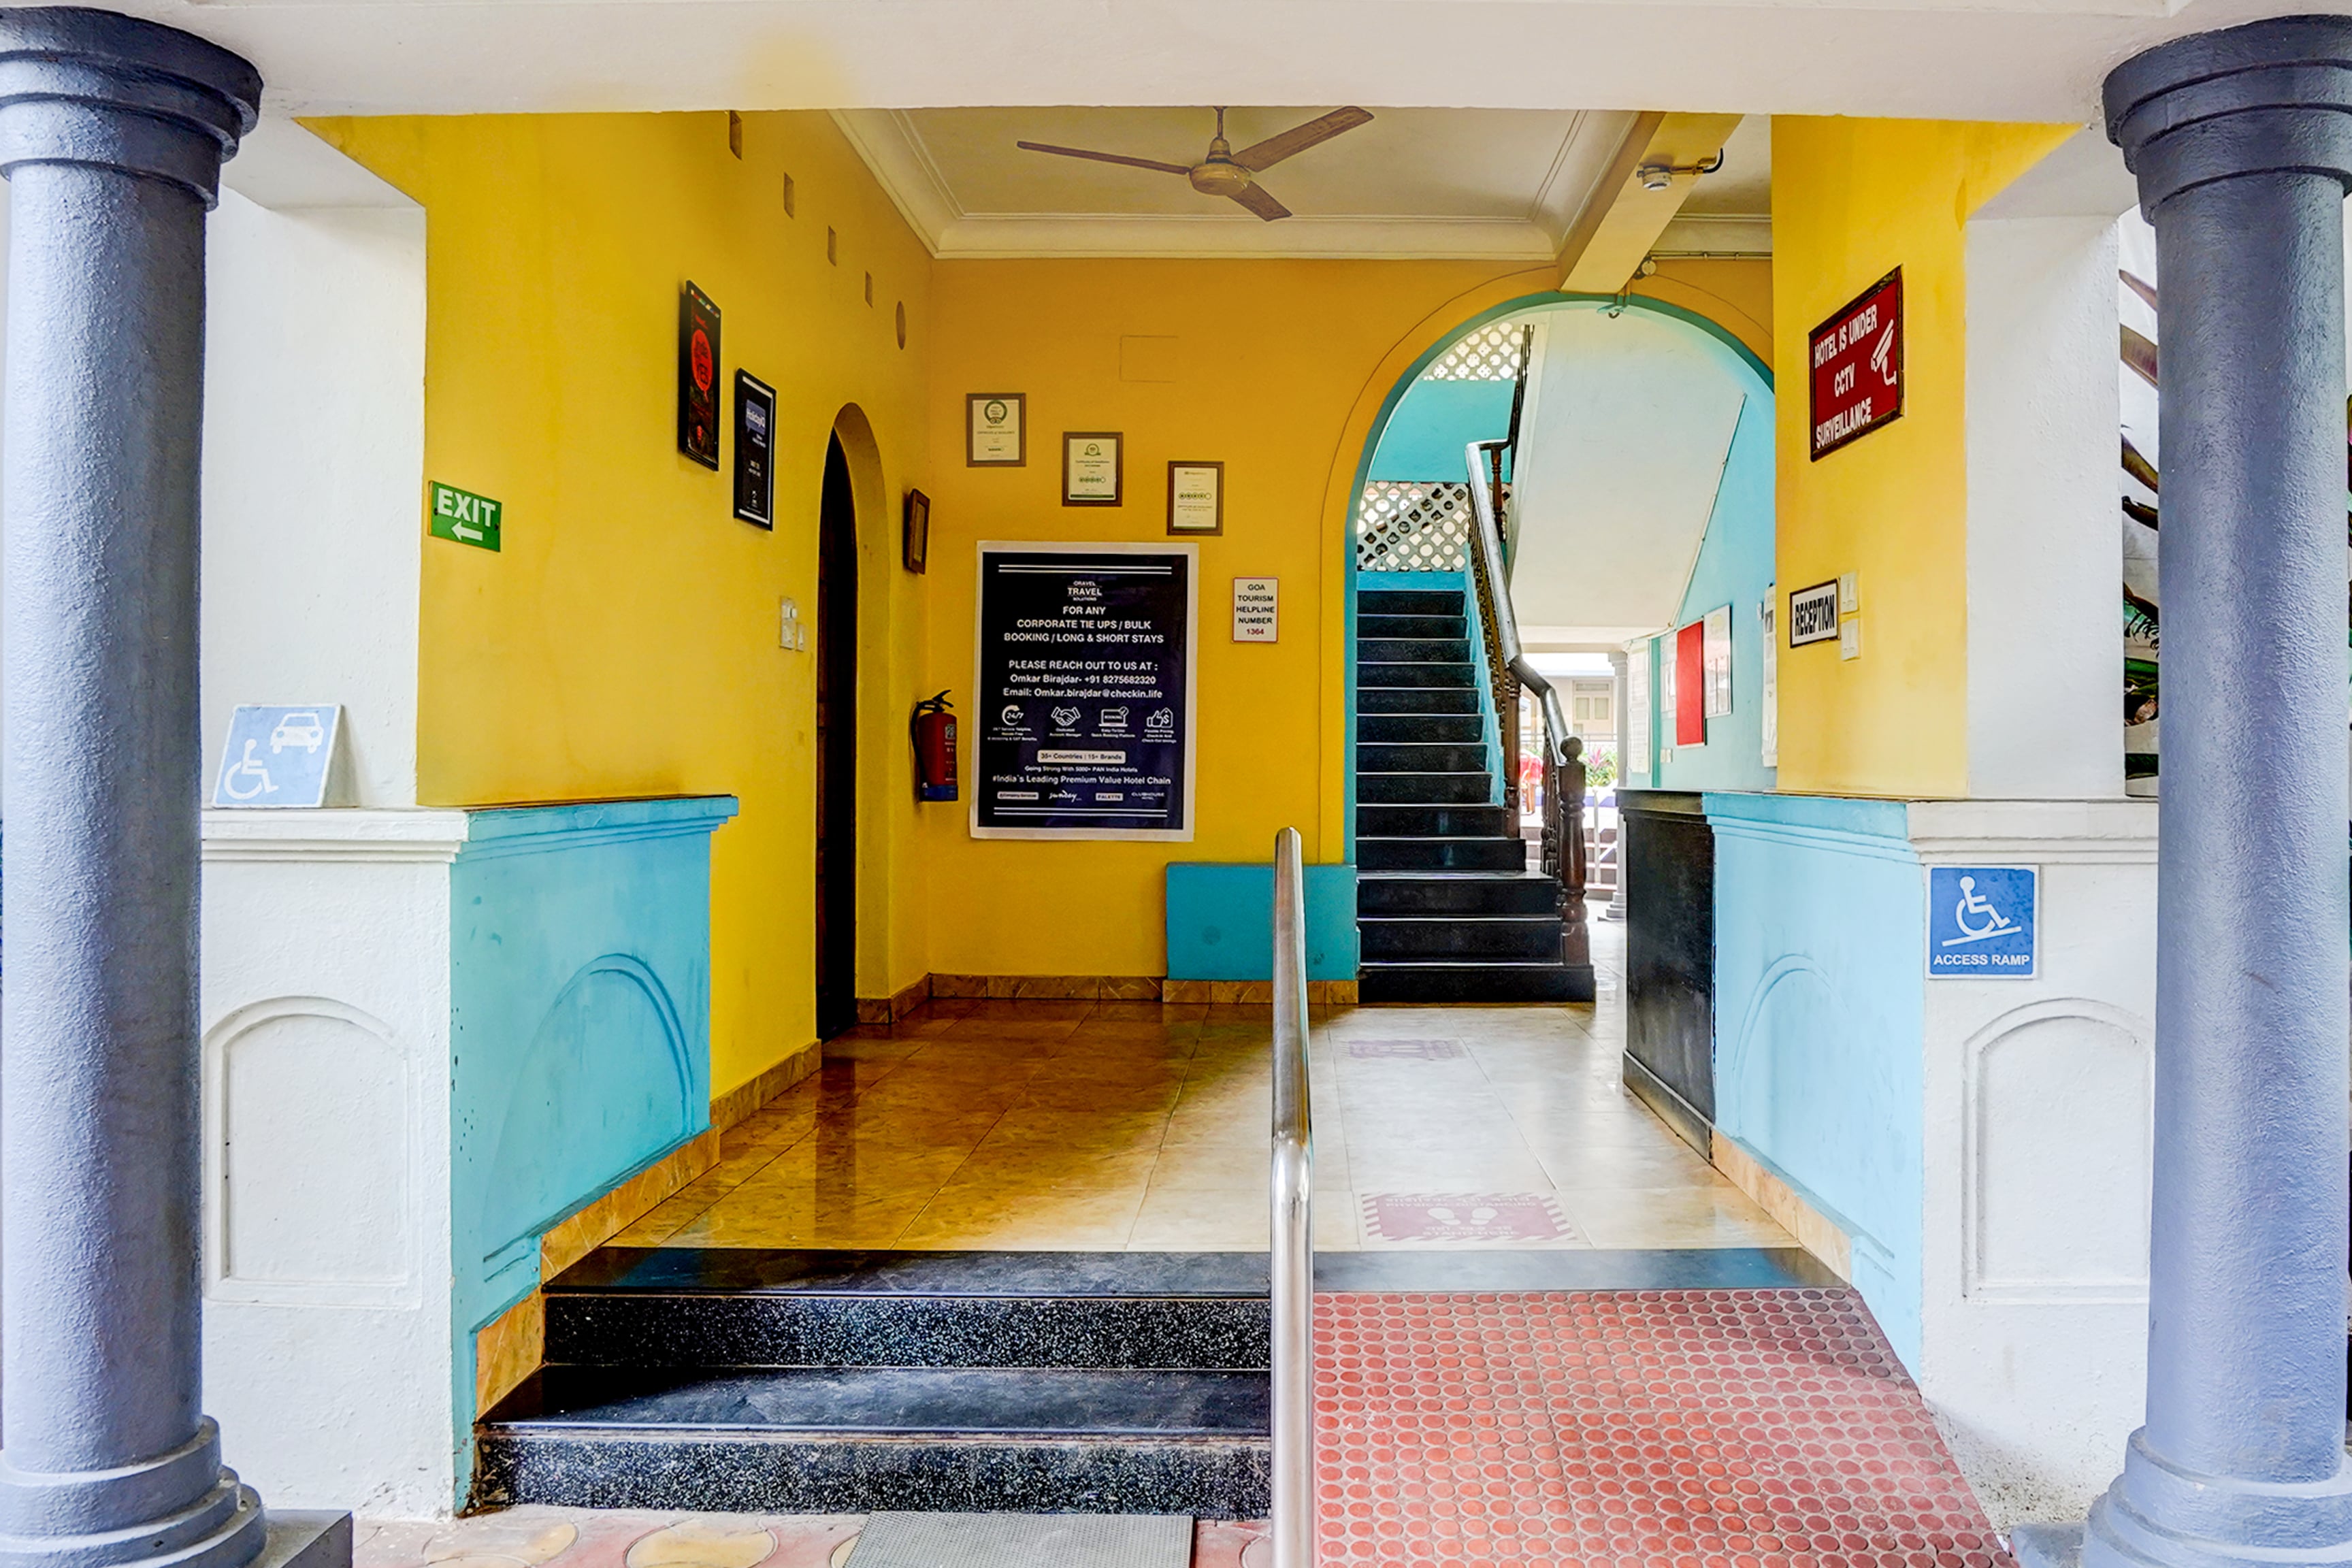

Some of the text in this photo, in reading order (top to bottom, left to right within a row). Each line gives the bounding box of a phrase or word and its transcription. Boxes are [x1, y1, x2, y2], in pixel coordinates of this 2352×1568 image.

[1814, 304, 1877, 369] HOTEL IS UNDER
[1834, 363, 1855, 397] CCTV
[1816, 397, 1872, 449] SURVEILLANCE
[437, 487, 496, 527] EXIT
[1067, 587, 1102, 596] TRAVEL
[1063, 606, 1106, 615] FOR ANY
[1795, 594, 1835, 636] RECEPTION
[1017, 619, 1077, 629] CORPORATE
[1081, 620, 1095, 629] TIE
[1096, 620, 1117, 630] UPS
[1124, 621, 1152, 630] BULK
[1004, 633, 1049, 642] BOOKING
[1057, 634, 1085, 642] LONG
[1087, 634, 1094, 642] &
[1096, 634, 1130, 643] SHORT
[1132, 634, 1164, 643] STAYS
[1009, 660, 1046, 670] PLEASE
[1049, 661, 1083, 670] REACH
[1085, 661, 1105, 670] OUT
[1108, 662, 1122, 670] TO
[1124, 662, 1137, 670] US
[1139, 662, 1152, 671] AT
[1010, 674, 1041, 683] Omkar
[1084, 675, 1100, 684] +91
[1102, 675, 1156, 685] 8275682320
[1002, 688, 1032, 697] Email:
[1026, 775, 1059, 785] Leading
[1060, 775, 1097, 784] Premium
[1147, 777, 1171, 785] Chain
[1933, 954, 2030, 966] ACCESS RAMP
